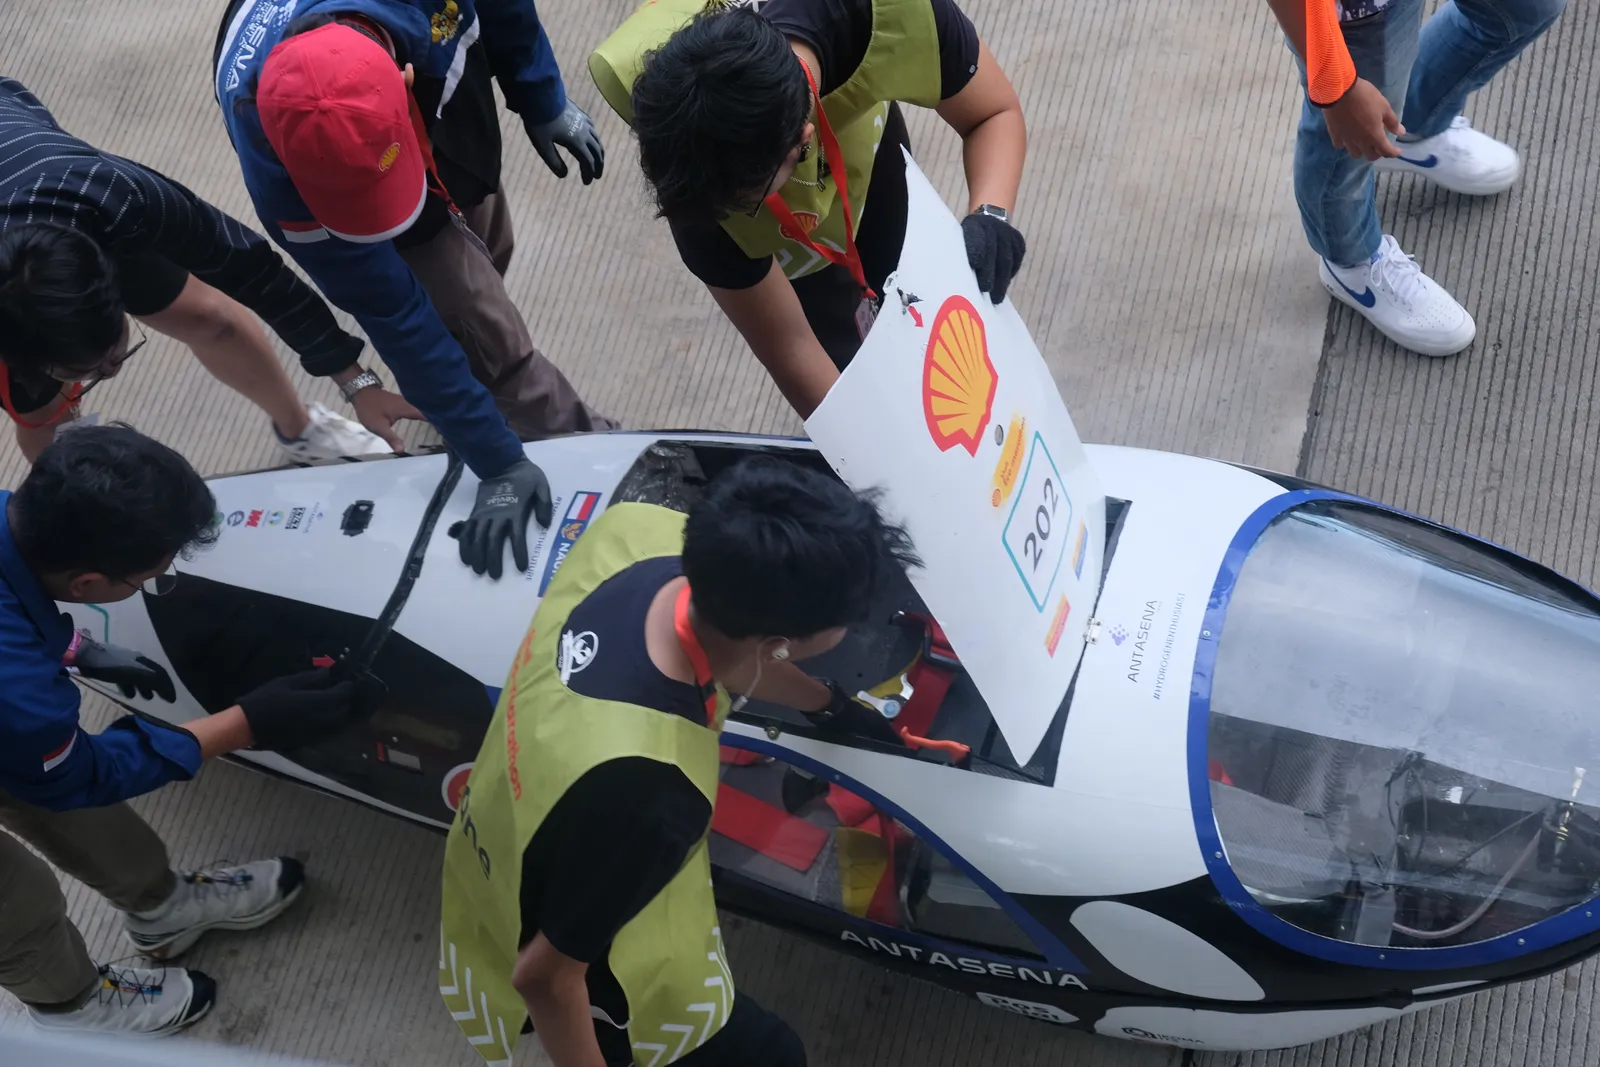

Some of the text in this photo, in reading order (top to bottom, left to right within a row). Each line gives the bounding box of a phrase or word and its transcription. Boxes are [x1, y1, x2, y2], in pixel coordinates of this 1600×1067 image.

[1024, 477, 1059, 573] 202
[1127, 600, 1158, 683] ANTASENA
[840, 928, 1089, 991] ANTASENA
